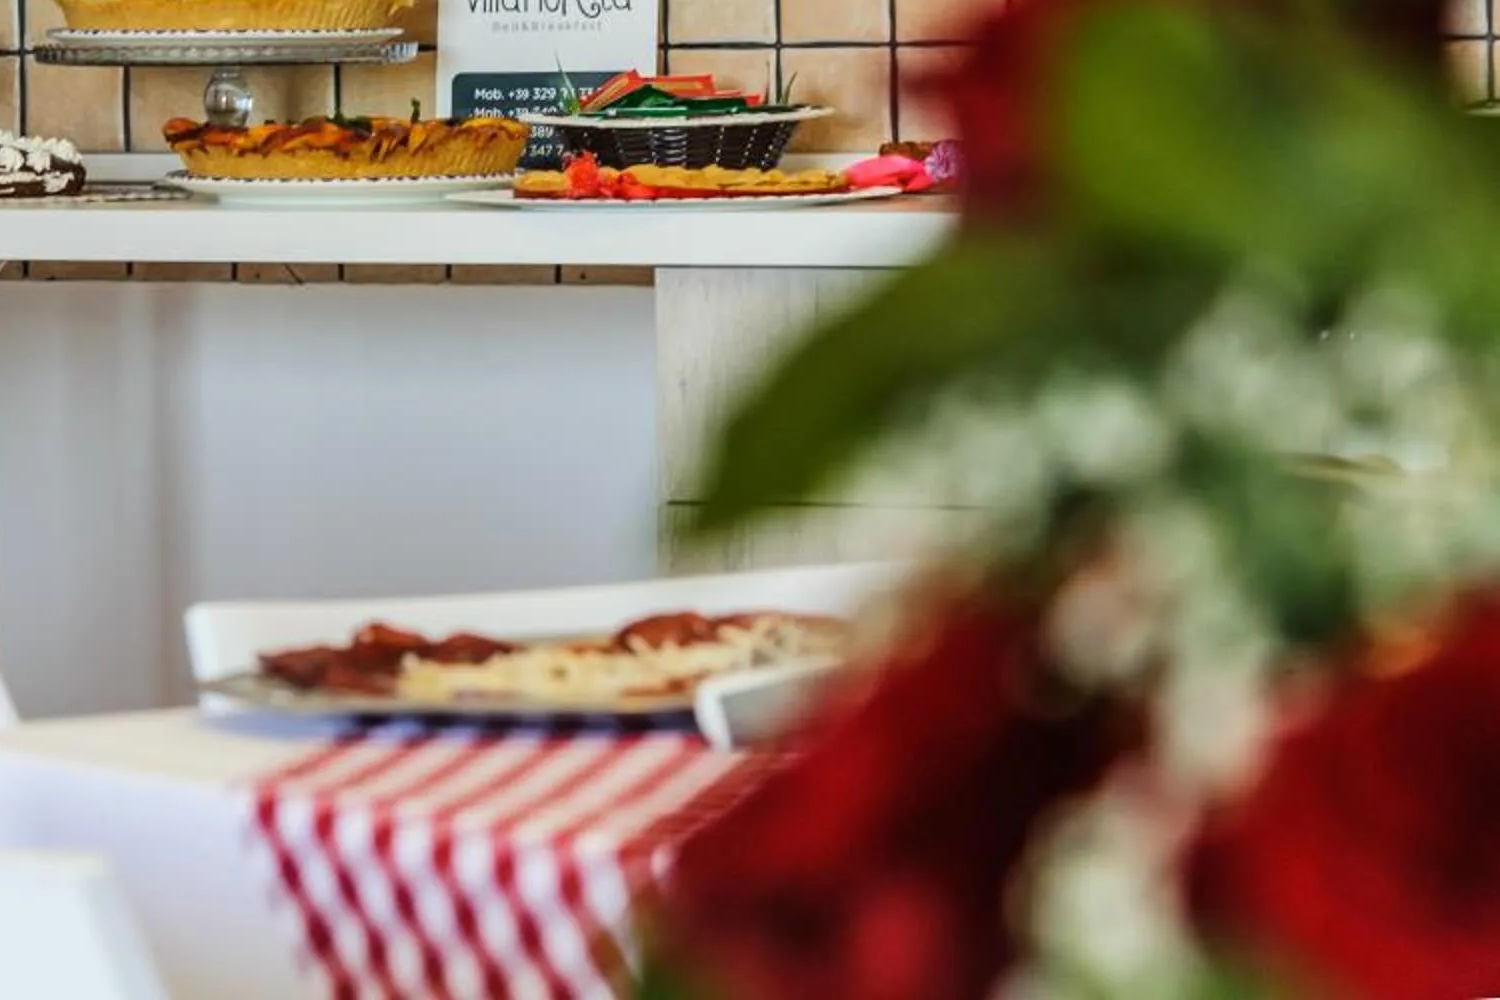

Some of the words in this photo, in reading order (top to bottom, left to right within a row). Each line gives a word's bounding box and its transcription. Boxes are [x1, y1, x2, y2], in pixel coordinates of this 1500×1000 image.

[474, 87, 504, 100] Mob.
[508, 88, 530, 100] +39
[532, 87, 557, 101] 329
[529, 144, 553, 157] 347
